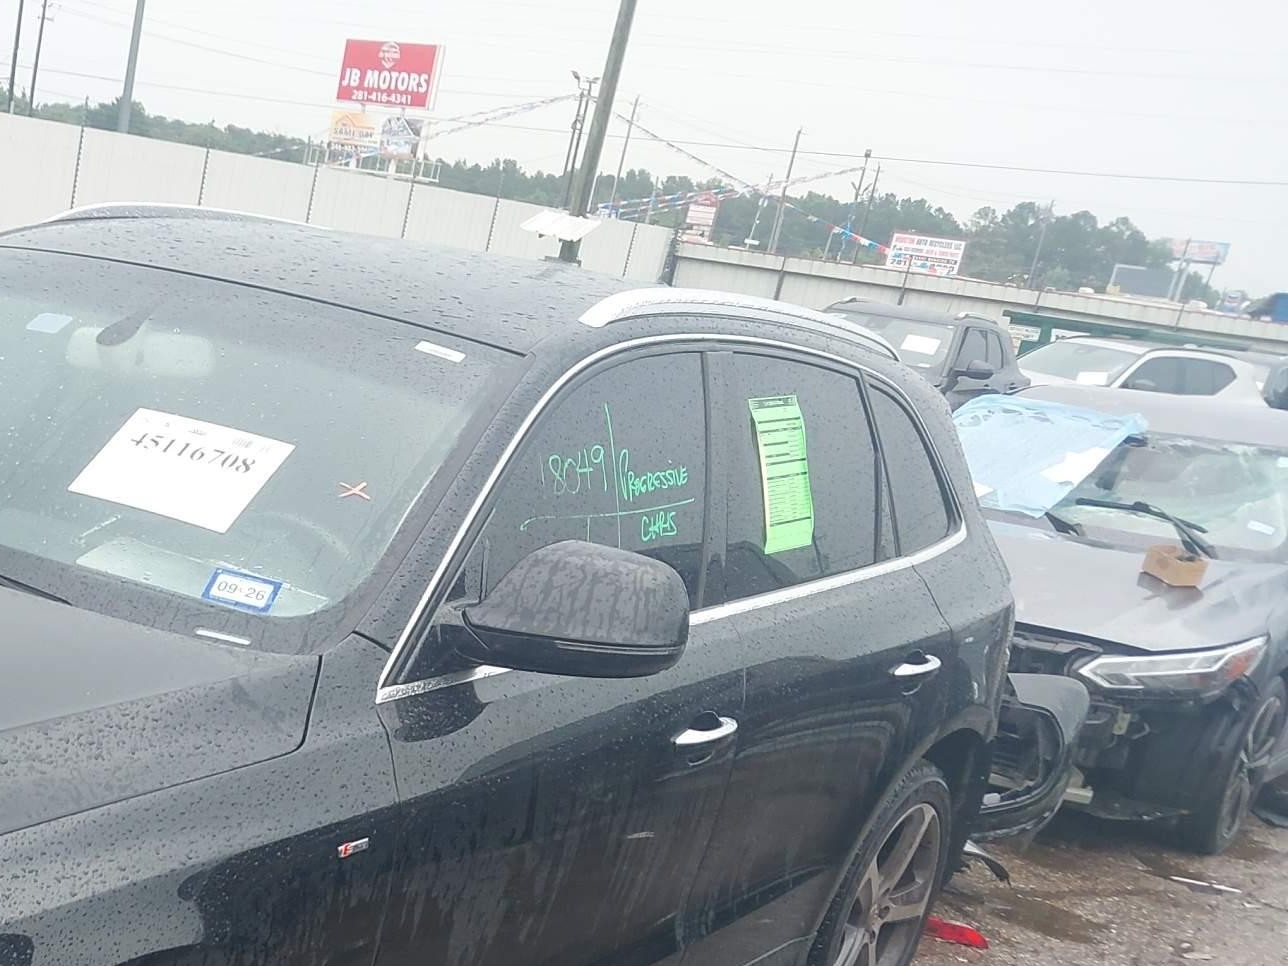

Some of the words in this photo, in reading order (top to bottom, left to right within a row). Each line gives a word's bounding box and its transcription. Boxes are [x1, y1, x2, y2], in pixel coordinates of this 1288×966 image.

[343, 68, 361, 87] JB
[365, 69, 429, 93] MOTORS
[352, 90, 412, 105] 281-416-4341
[130, 432, 256, 474] 45116708
[217, 581, 238, 594] 09
[245, 587, 266, 601] 26
